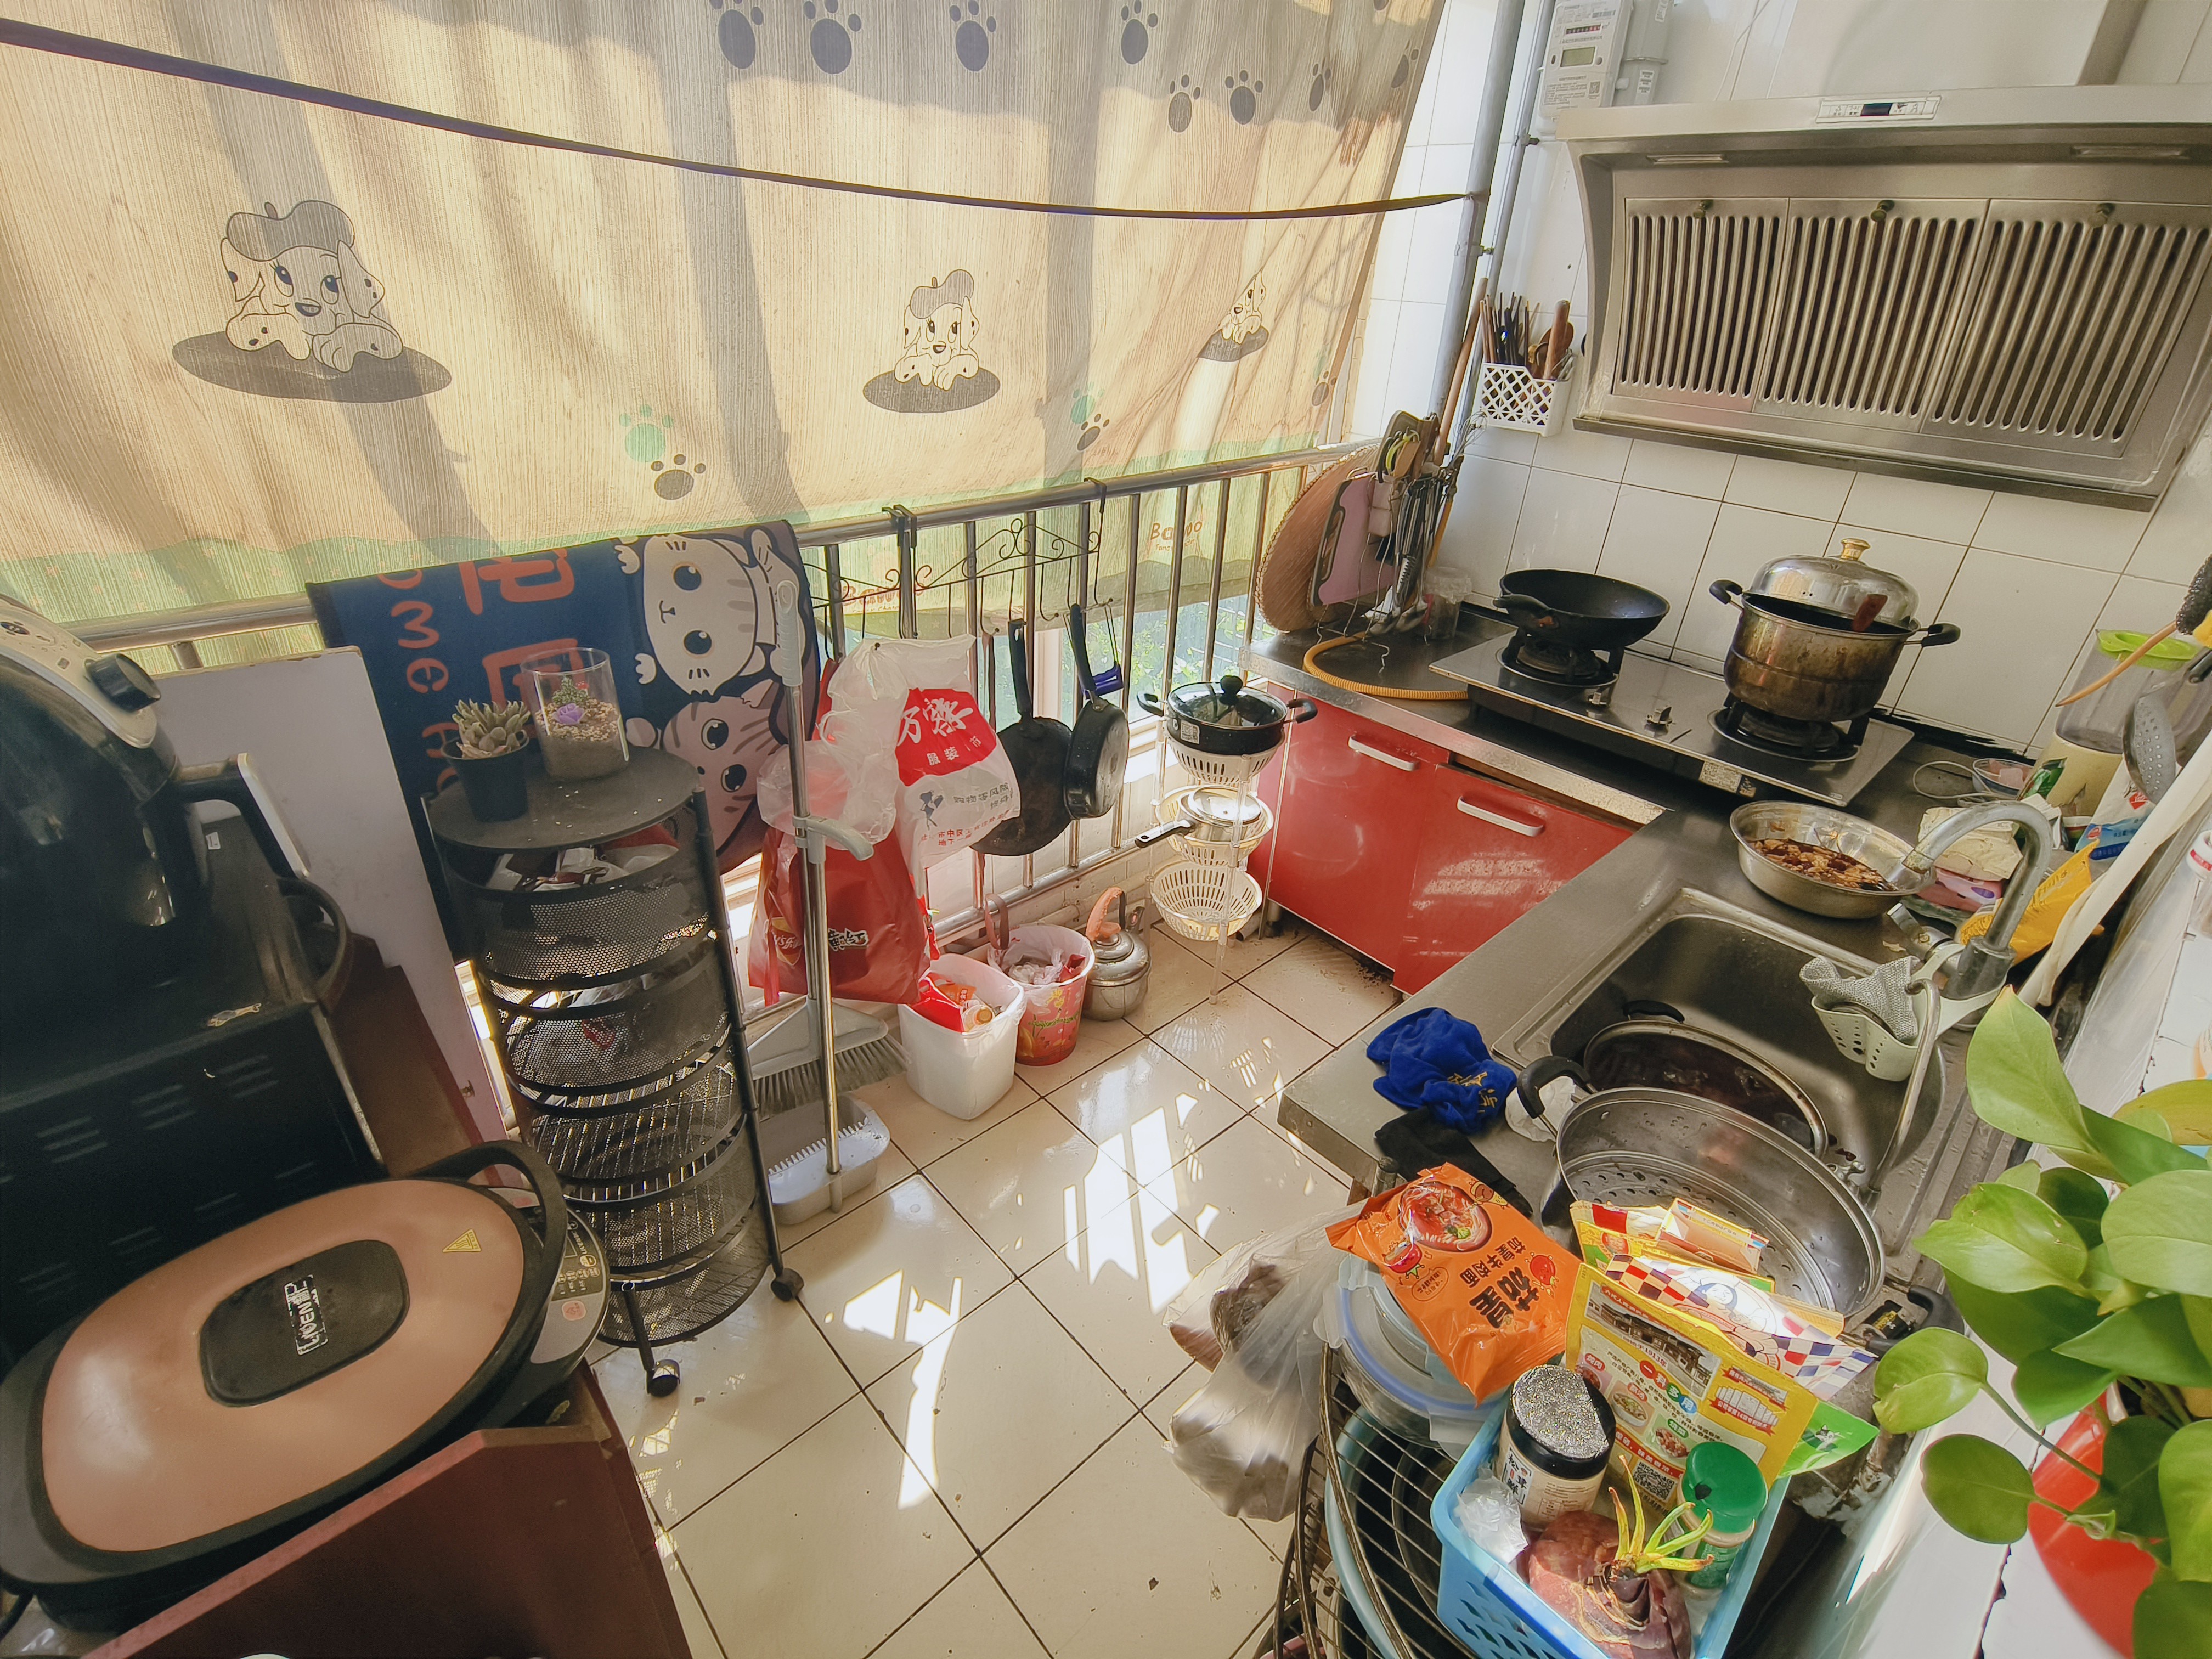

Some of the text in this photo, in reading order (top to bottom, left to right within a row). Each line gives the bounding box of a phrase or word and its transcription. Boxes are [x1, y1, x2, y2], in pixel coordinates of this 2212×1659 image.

[1460, 1236, 1526, 1288] 茄皇牛肉面
[1469, 1266, 1541, 1329] 茄皇
[1642, 1364, 1695, 1412] 一料多用
